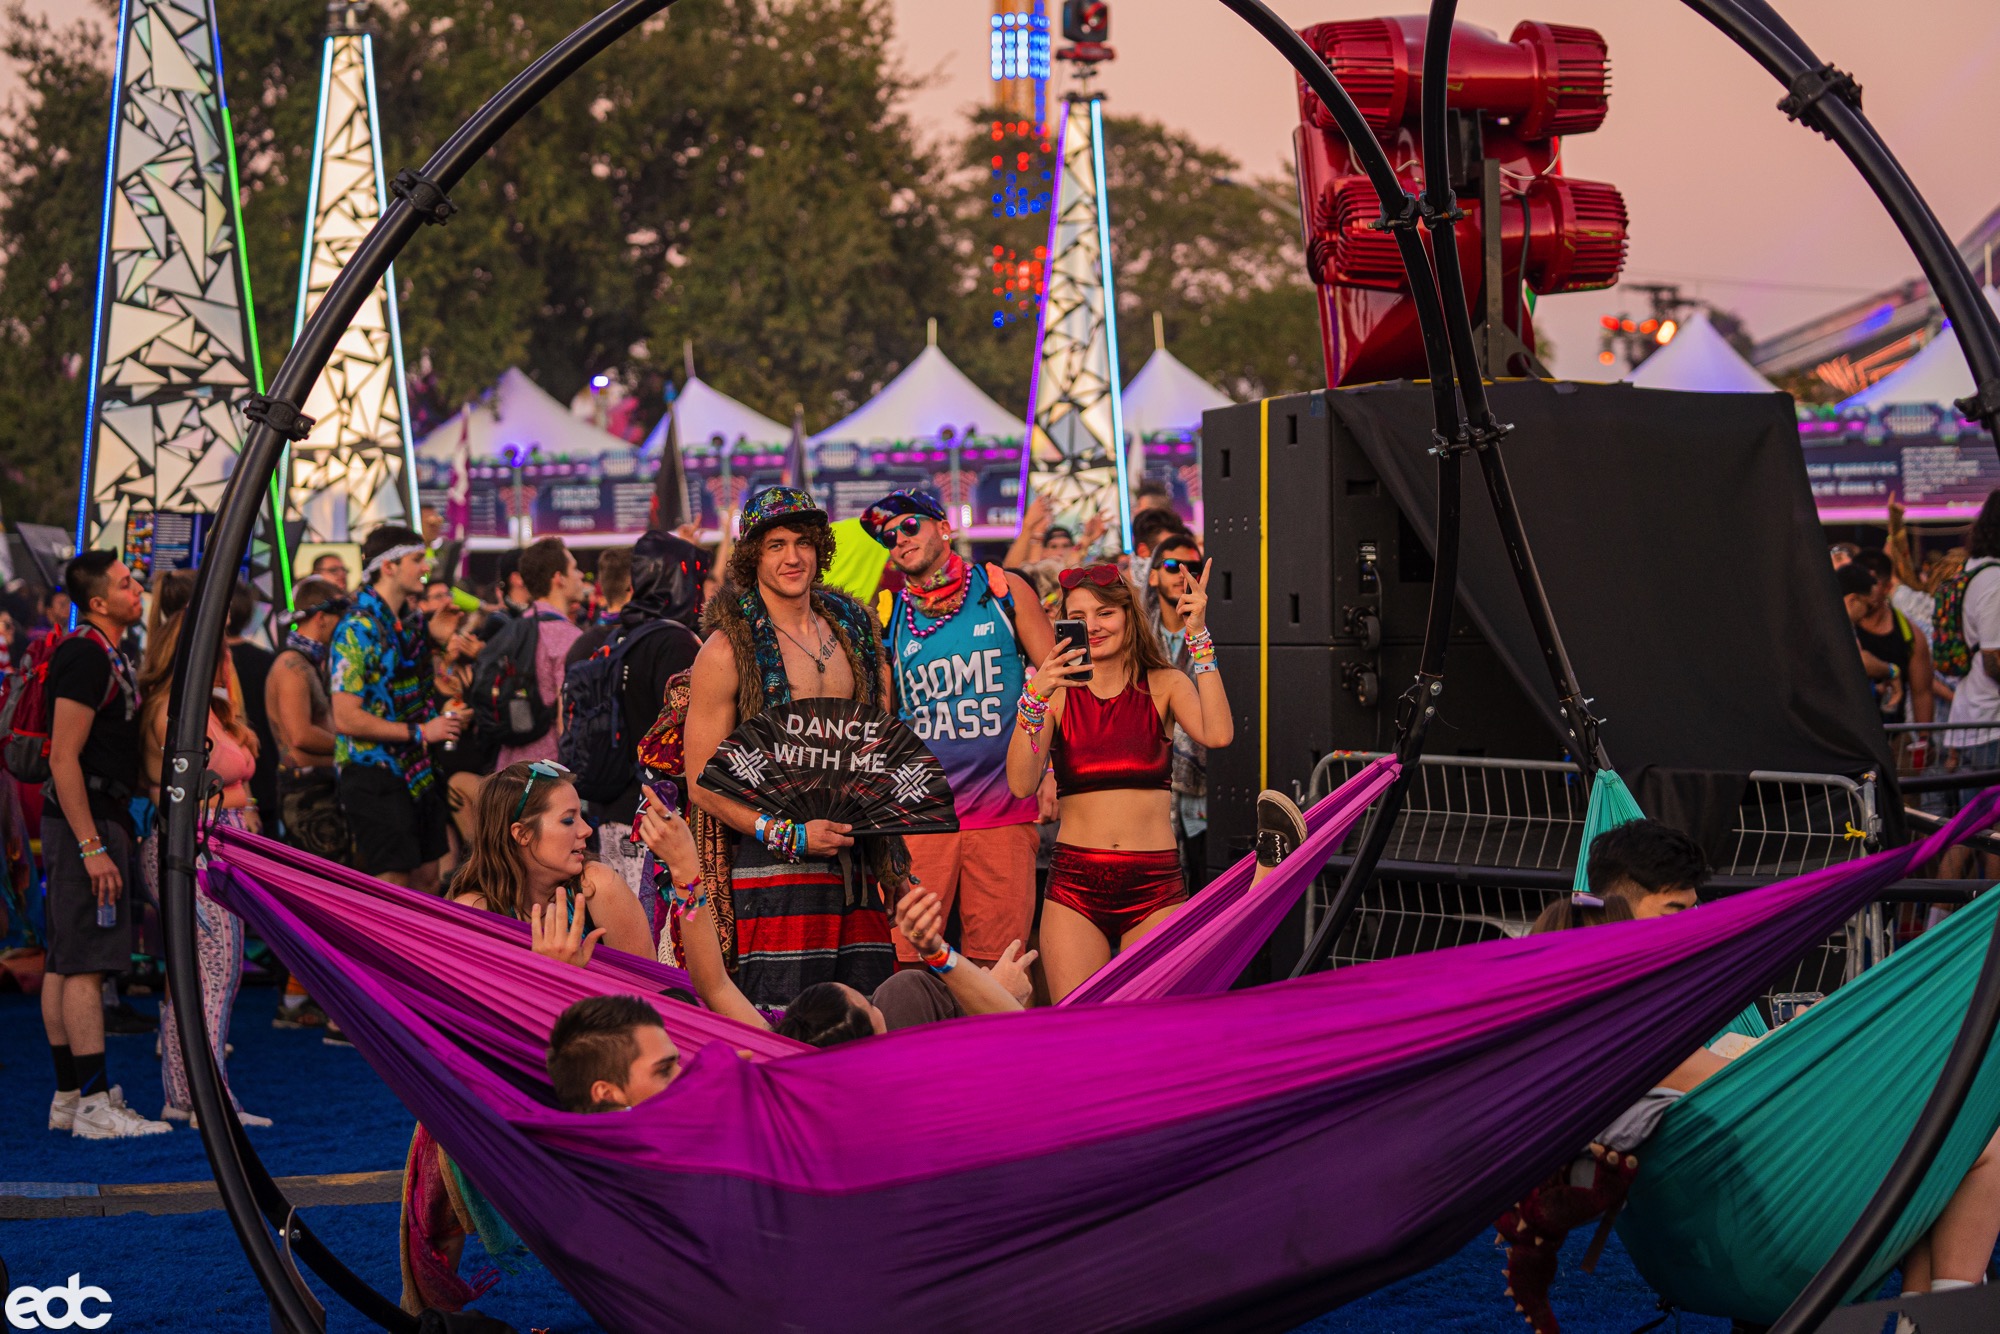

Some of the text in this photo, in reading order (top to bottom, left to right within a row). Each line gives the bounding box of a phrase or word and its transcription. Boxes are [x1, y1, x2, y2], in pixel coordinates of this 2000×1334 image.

[905, 648, 1004, 706] HOME
[786, 713, 880, 742] DANCE
[913, 696, 1002, 740] BASS
[773, 742, 887, 773] WITH ME
